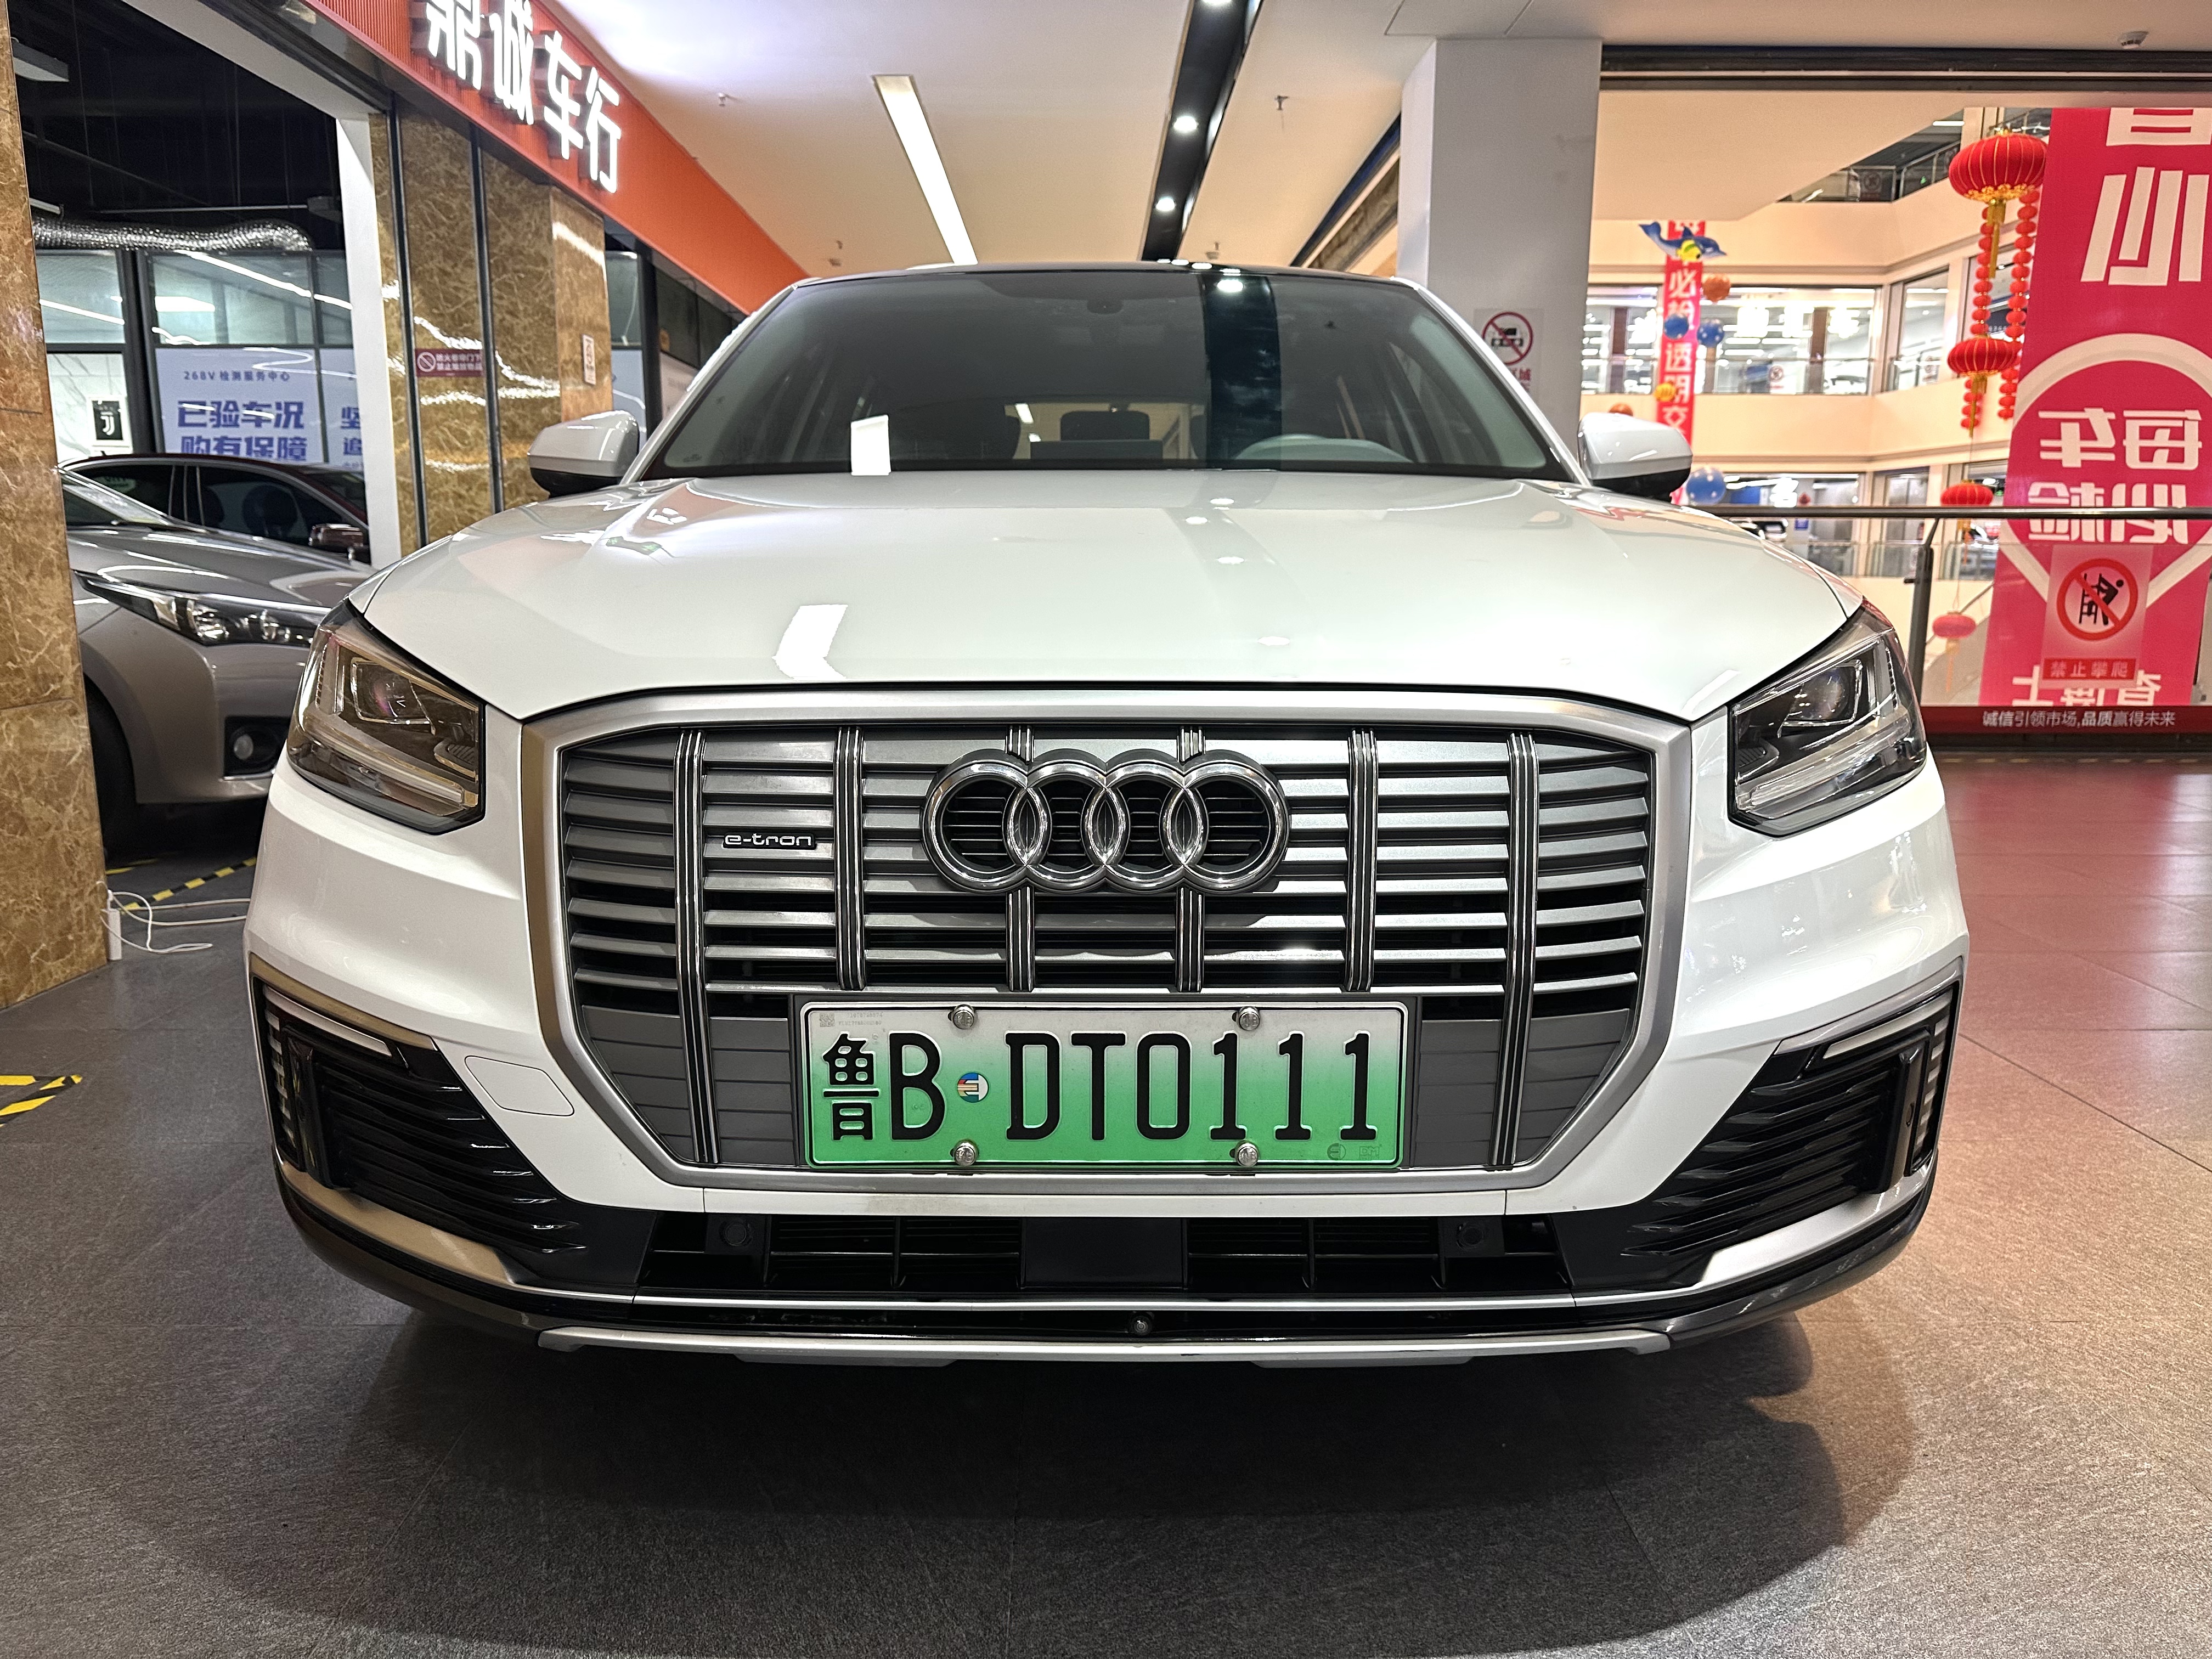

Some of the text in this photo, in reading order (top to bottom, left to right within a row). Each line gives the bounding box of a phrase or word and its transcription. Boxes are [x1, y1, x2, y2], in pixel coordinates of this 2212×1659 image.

[220, 371, 290, 382] 检测服务中心
[178, 400, 304, 429] 已验车况
[181, 436, 307, 461] 购有保障
[2051, 661, 2128, 679] 禁止攀爬
[725, 833, 812, 846] e-tron
